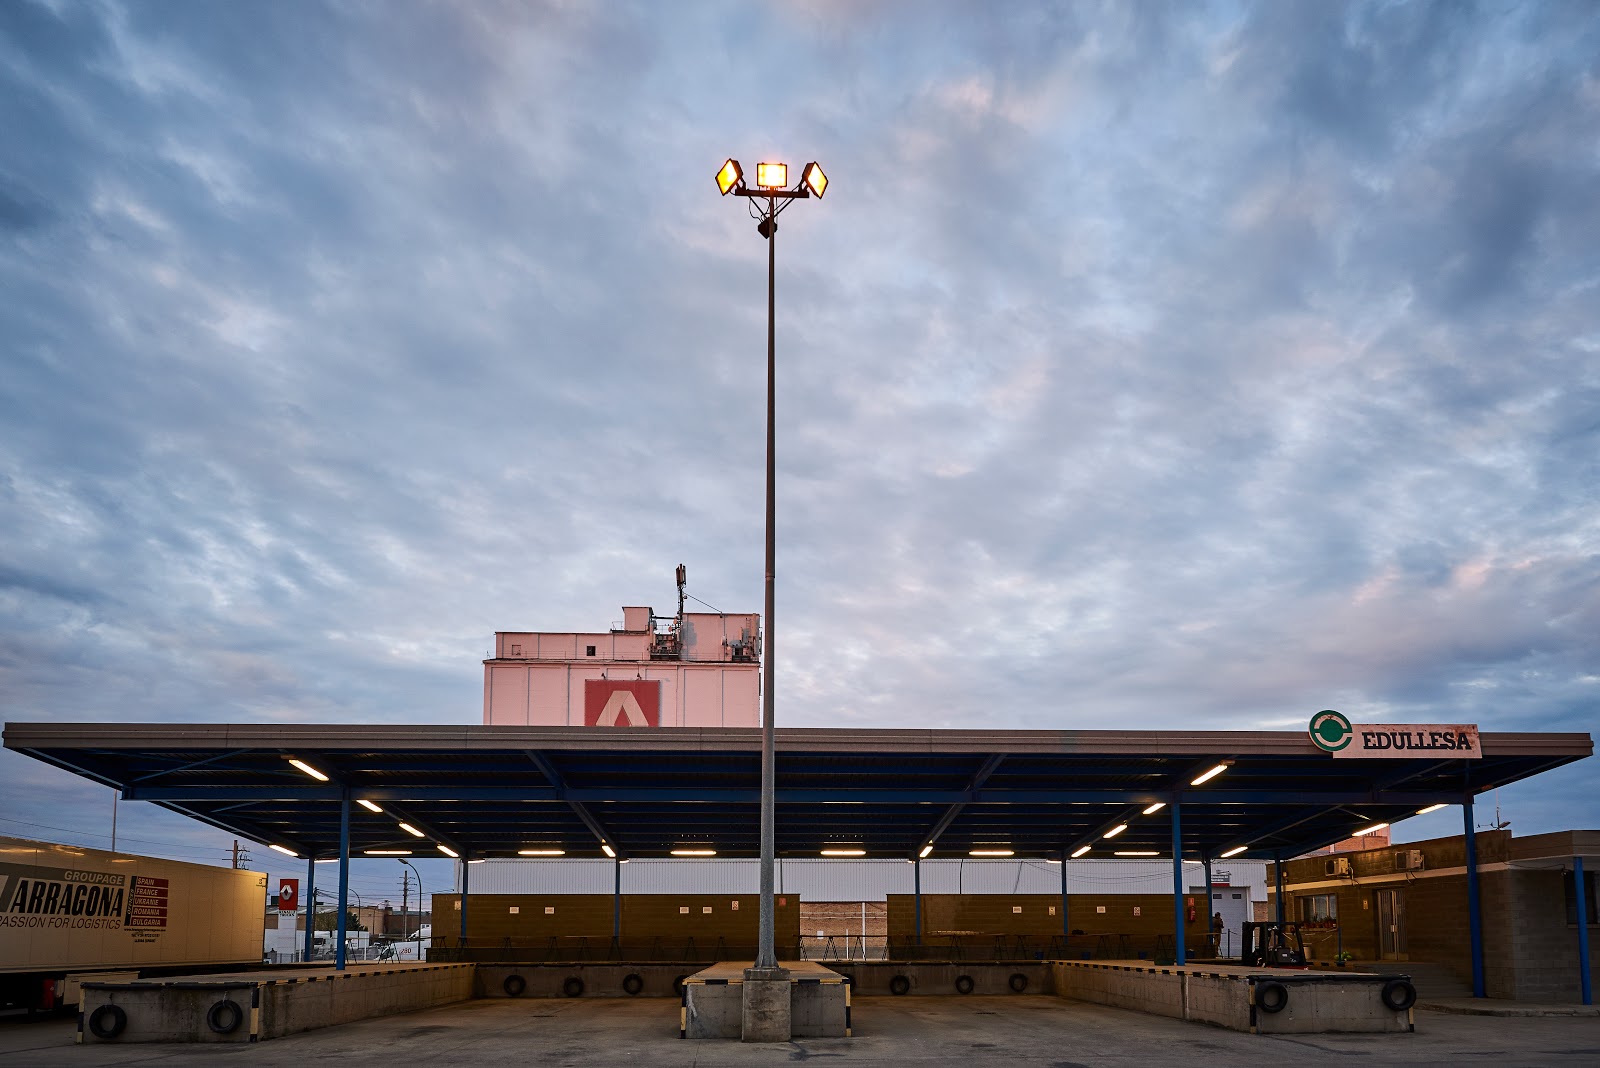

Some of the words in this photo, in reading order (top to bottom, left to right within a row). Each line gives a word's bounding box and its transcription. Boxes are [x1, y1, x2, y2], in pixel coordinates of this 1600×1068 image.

[1361, 732, 1472, 750] EDULLESA
[64, 870, 124, 885] GROUPAGE
[137, 877, 155, 886] SPAIN
[136, 888, 159, 896] FRANCE
[10, 880, 124, 917] ARRAGONA
[134, 897, 159, 906] UKRAINE
[133, 907, 160, 916] ROMANIA
[48, 917, 70, 928] FOR
[71, 918, 121, 929] LOGISTICS
[132, 918, 161, 926] BULGARIA
